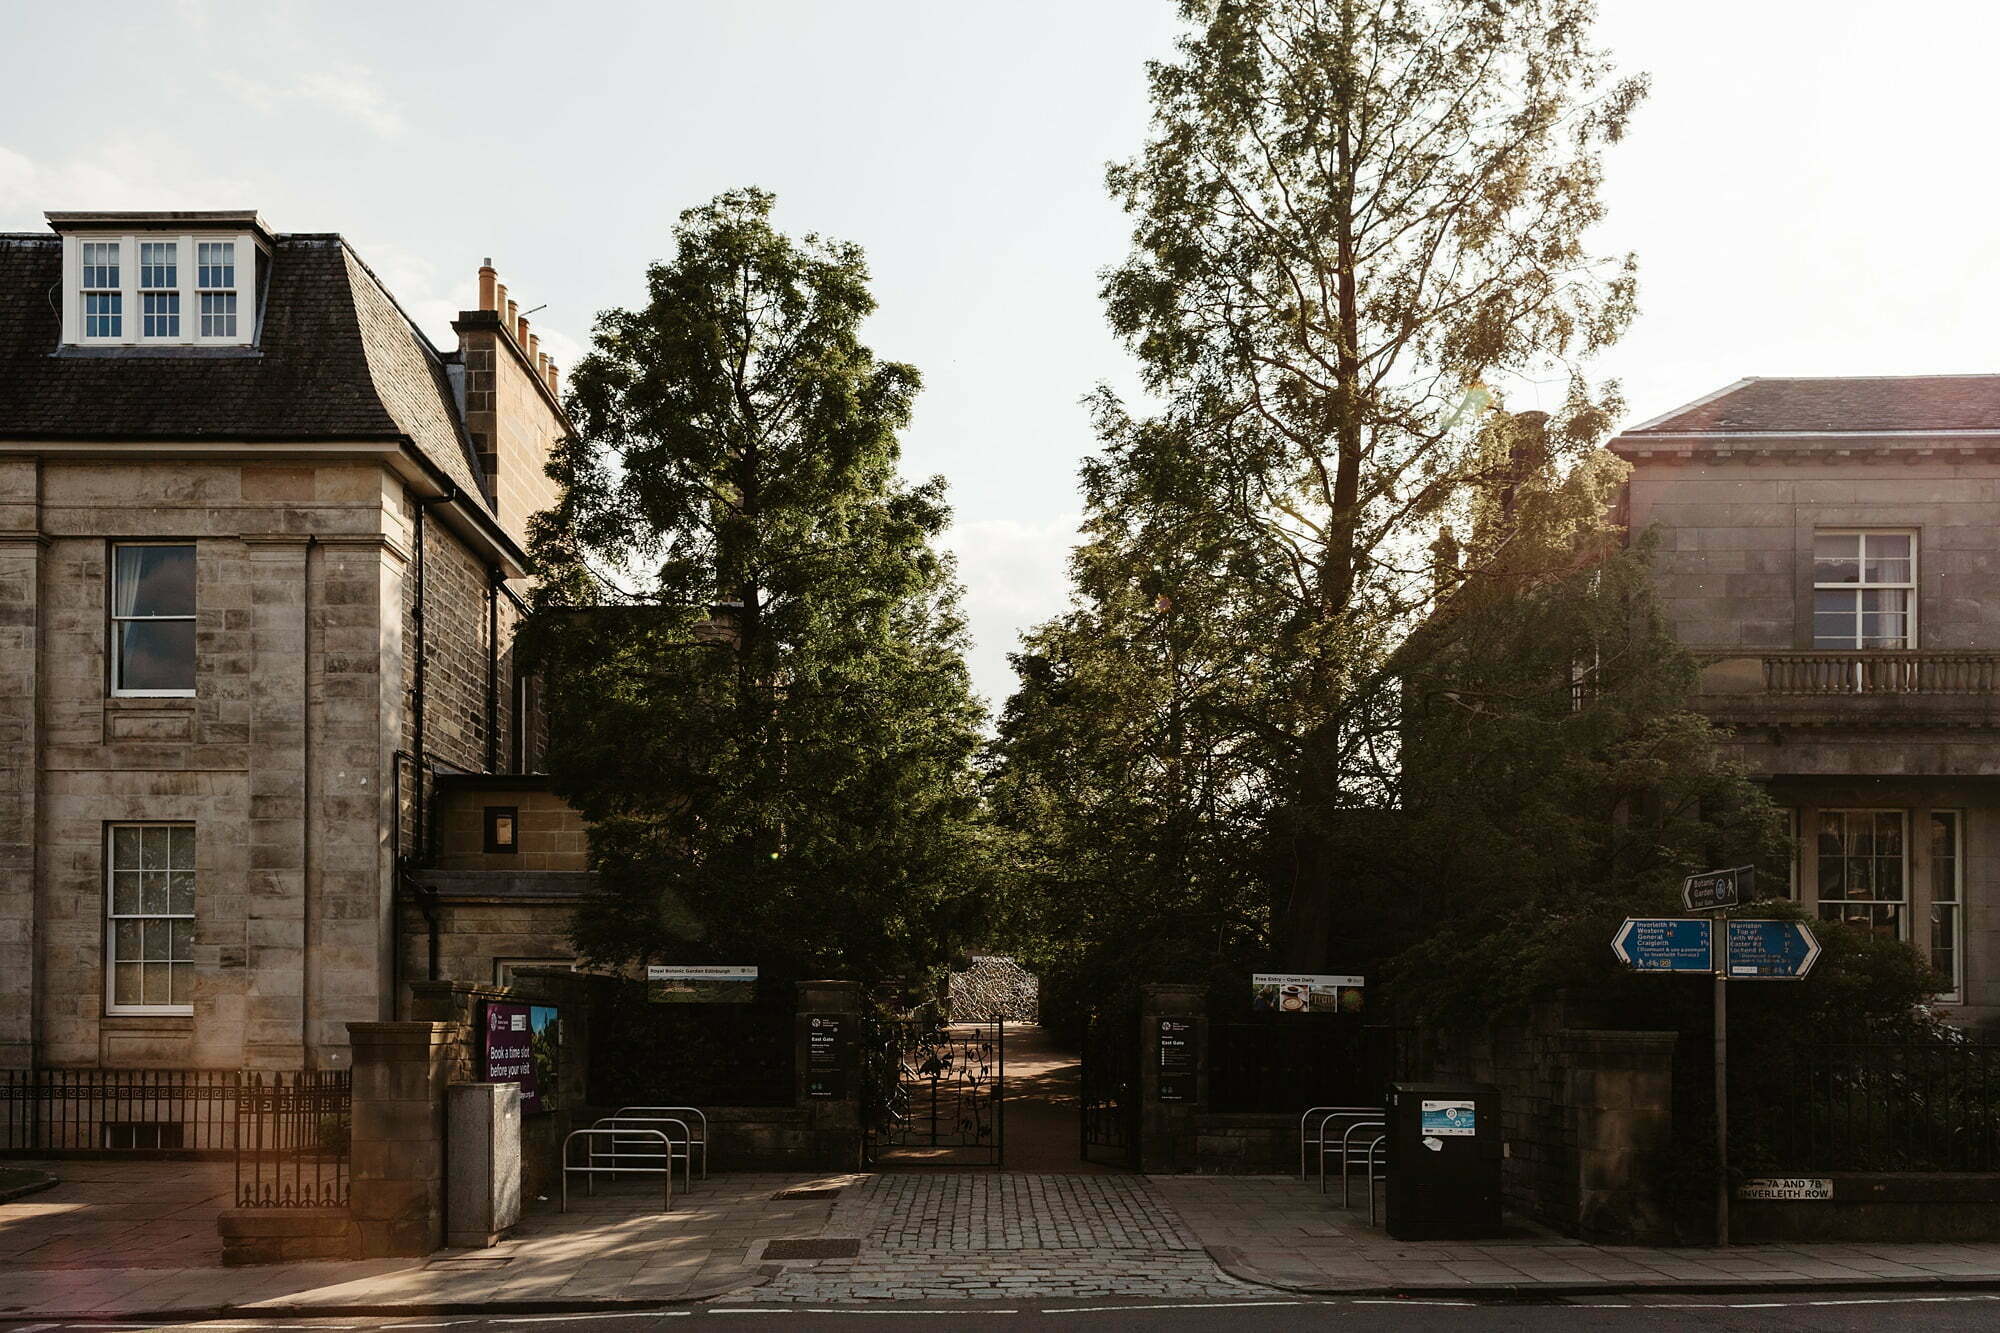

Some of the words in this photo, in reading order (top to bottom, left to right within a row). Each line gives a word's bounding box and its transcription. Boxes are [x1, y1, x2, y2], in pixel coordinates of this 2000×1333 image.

[1694, 879, 1714, 888] Botanic
[1694, 888, 1714, 897] Garden
[490, 1046, 504, 1060] Book
[504, 1050, 509, 1058] a
[509, 1046, 521, 1059] time
[521, 1045, 530, 1058] slot
[490, 1063, 508, 1077] before
[508, 1064, 520, 1078] your
[520, 1063, 530, 1075] visit
[1767, 1180, 1779, 1188] 7A
[1783, 1180, 1806, 1188] AND
[1809, 1180, 1822, 1188] 7B
[1805, 1190, 1829, 1198] ROW
